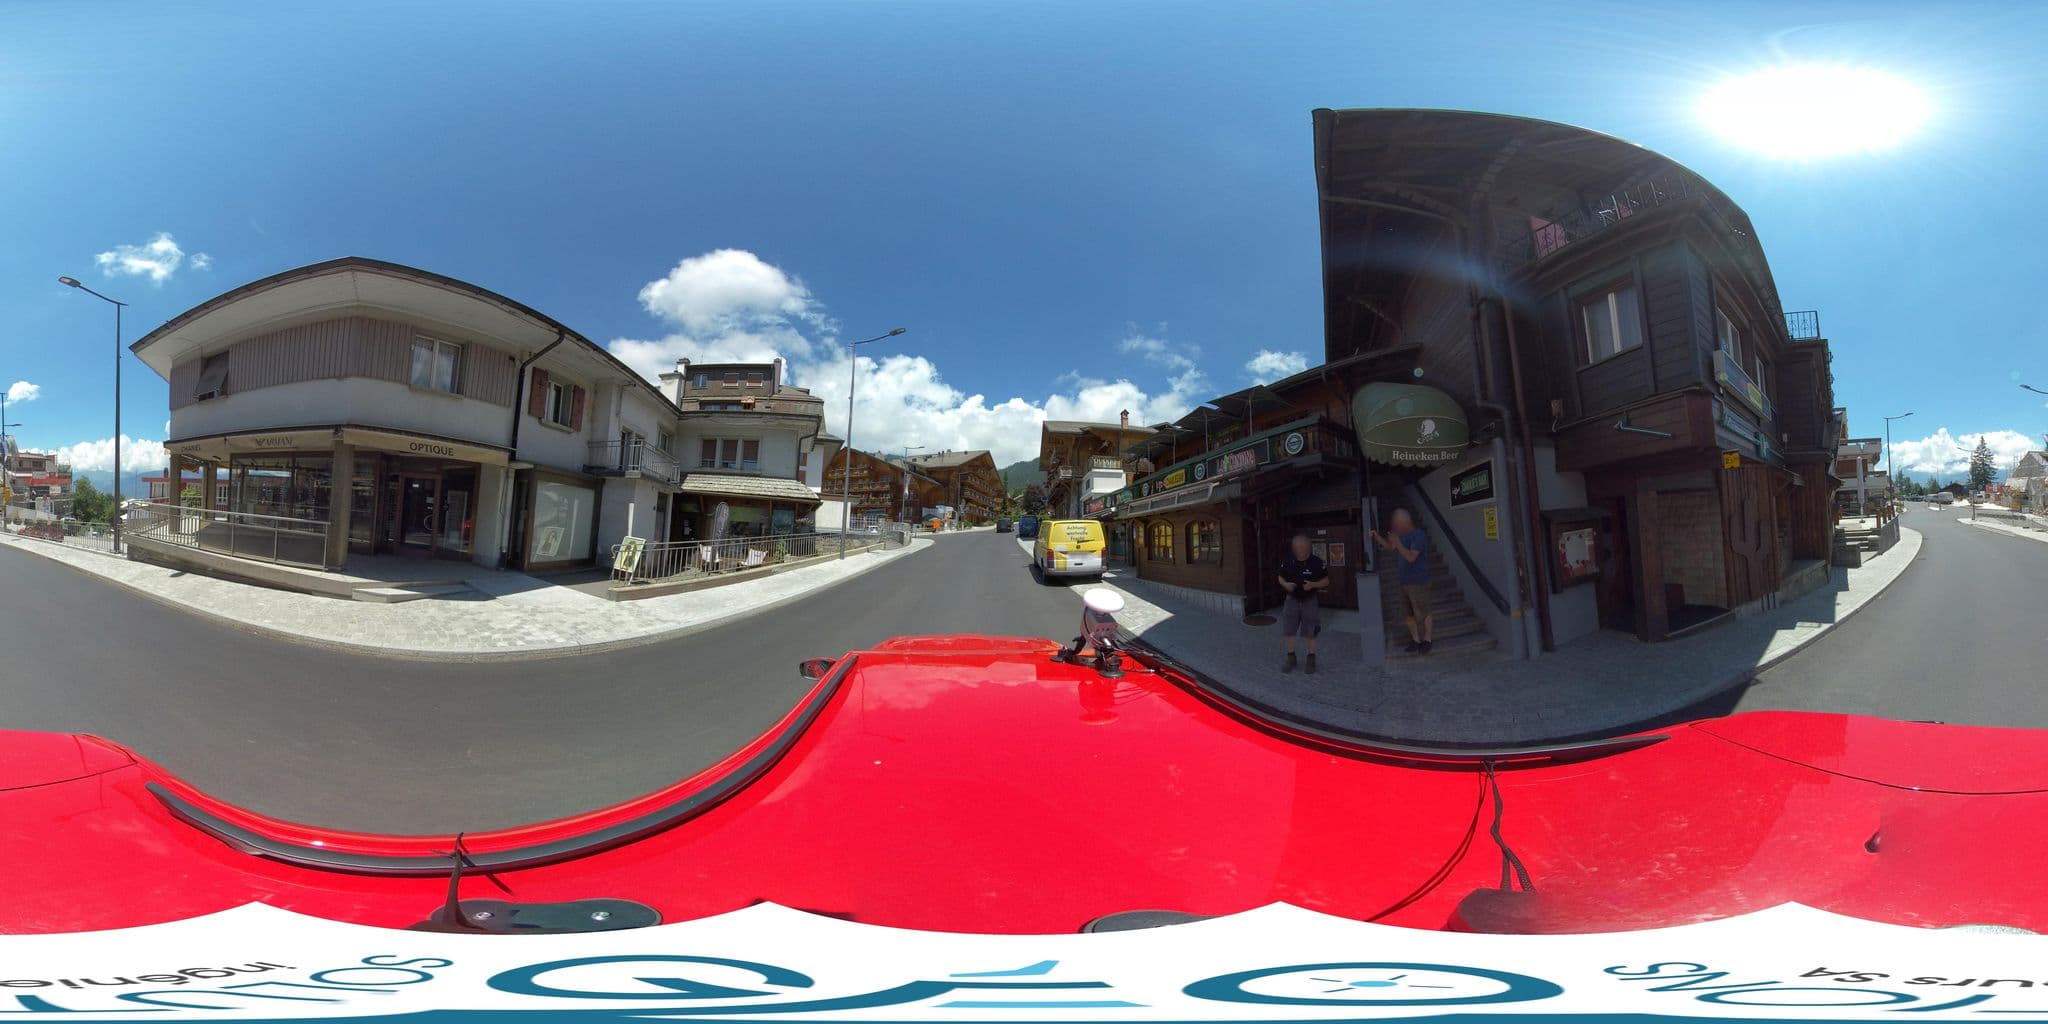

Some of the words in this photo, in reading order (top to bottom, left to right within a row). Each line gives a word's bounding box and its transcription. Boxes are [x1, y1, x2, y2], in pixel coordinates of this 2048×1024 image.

[409, 442, 455, 456] OPTIQUE
[1392, 450, 1439, 461] Heineken
[1440, 451, 1459, 460] Beer
